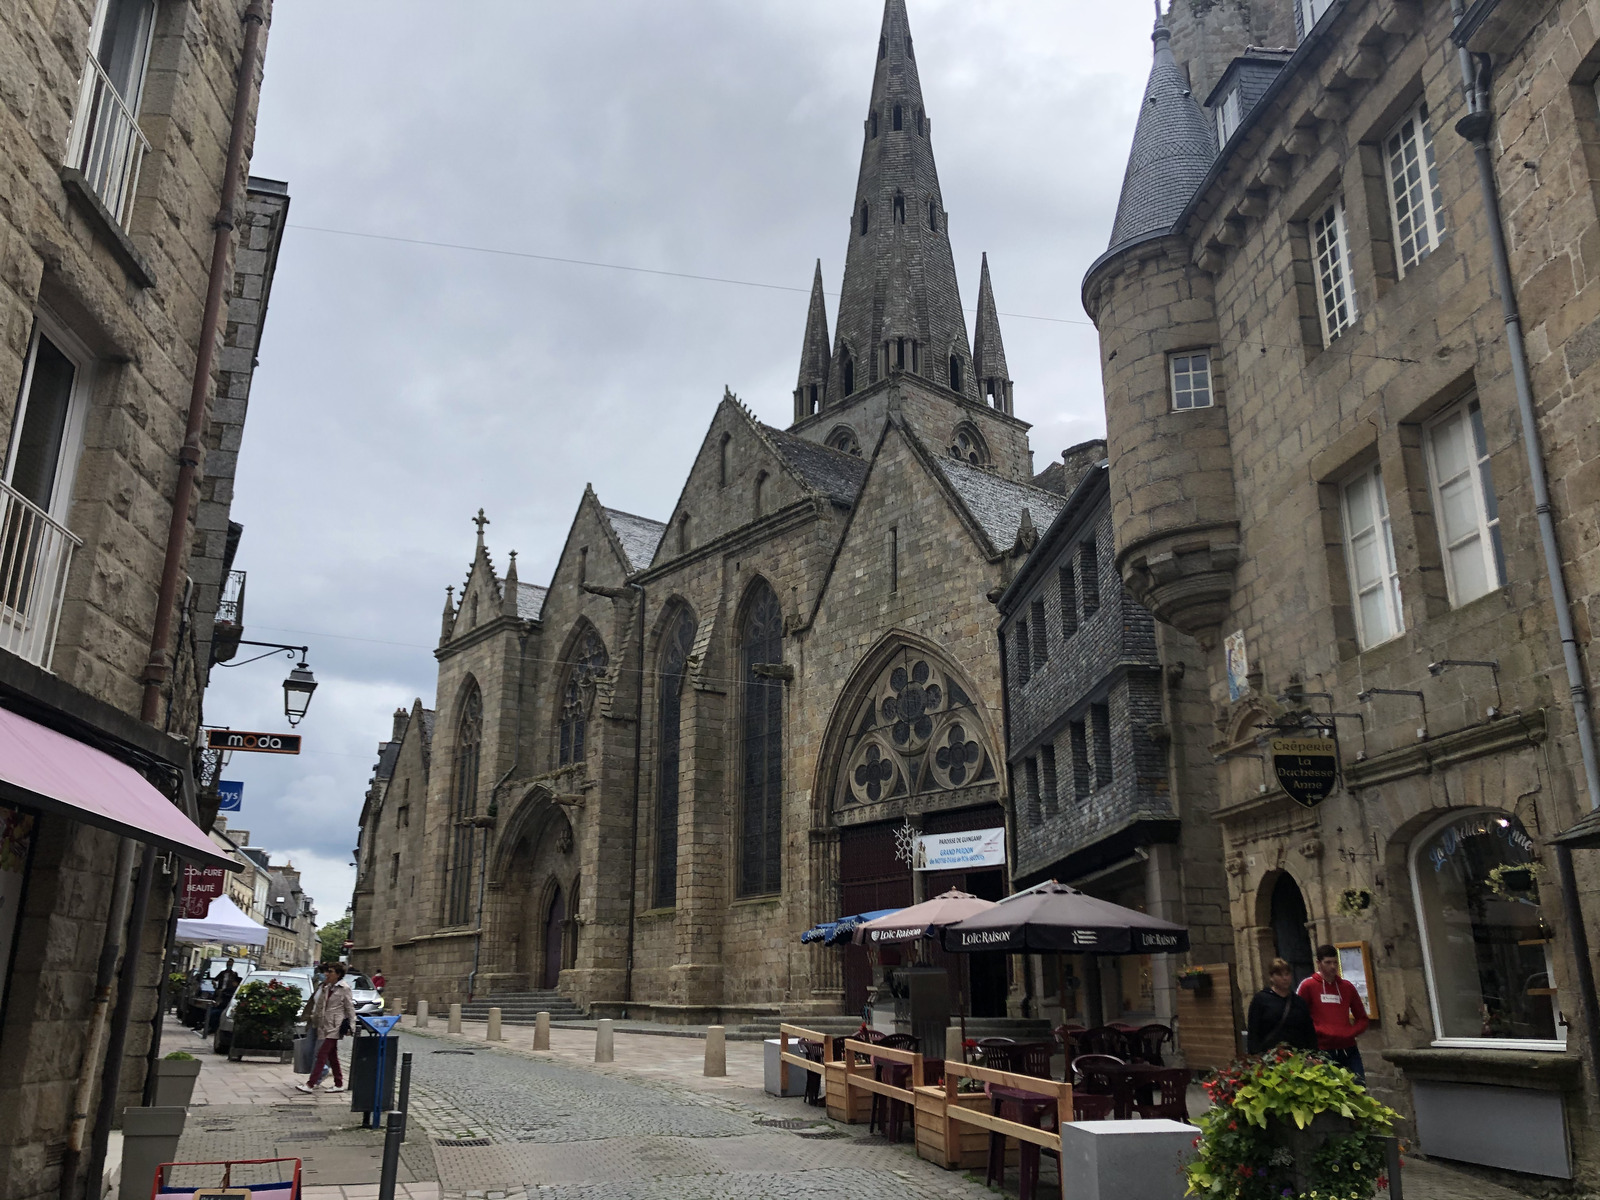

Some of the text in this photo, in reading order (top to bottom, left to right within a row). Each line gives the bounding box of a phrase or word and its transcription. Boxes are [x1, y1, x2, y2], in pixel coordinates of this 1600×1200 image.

[1273, 741, 1332, 752] Crêperie
[1298, 757, 1312, 766] La
[1278, 767, 1333, 777] Duchesse
[1293, 780, 1322, 789] Anne
[938, 837, 956, 845] PAROISSE
[962, 835, 982, 843] GUINGAMP
[939, 848, 956, 857] GRAND
[956, 846, 974, 855] PARDON
[184, 868, 223, 877] COIFURE
[186, 883, 216, 892] BEAUTÉ
[982, 930, 1011, 944] RAISON
